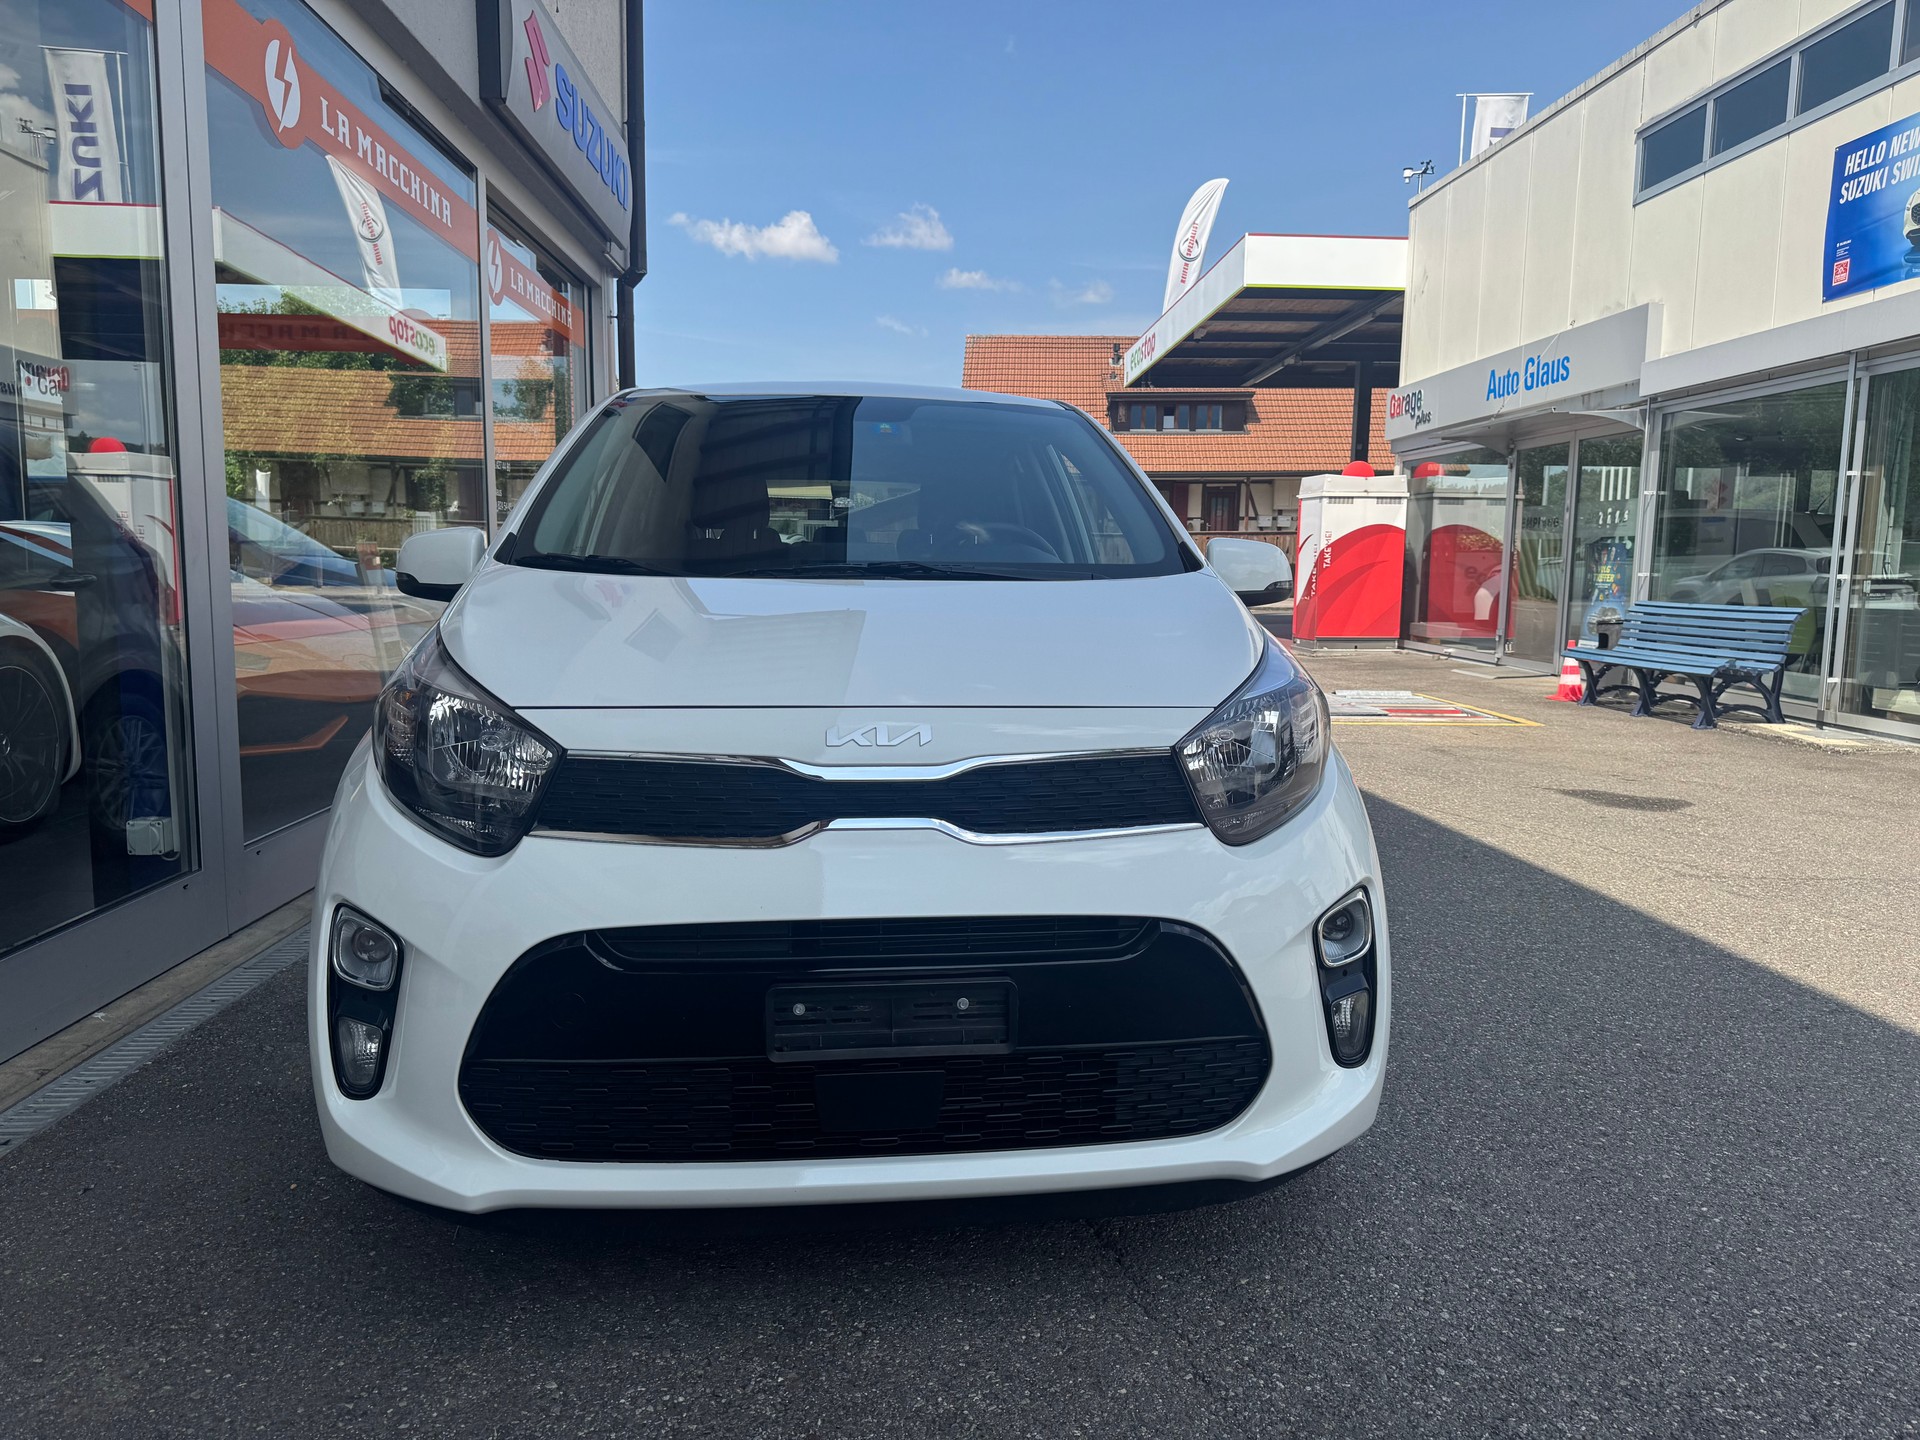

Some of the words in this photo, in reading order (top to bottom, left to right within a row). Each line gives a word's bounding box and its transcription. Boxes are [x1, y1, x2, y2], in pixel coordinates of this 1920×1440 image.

[555, 63, 628, 211] SUZUKI
[1844, 140, 1887, 177] HELLO
[1889, 126, 1920, 159] NEW
[320, 95, 351, 150] LA
[356, 125, 452, 228] MACCHINA
[1839, 165, 1889, 204] SUZUKI
[1891, 153, 1920, 185] SWI
[1186, 220, 1199, 257] SPEZIALIST
[510, 267, 525, 296] LA
[526, 279, 573, 330] MACCHINA
[1130, 332, 1156, 371] ecostop
[1486, 369, 1519, 401] Auto
[1524, 355, 1571, 391] Glaus
[1390, 389, 1423, 420] Garage
[1415, 411, 1432, 429] plus
[1323, 547, 1332, 568] TAKE
[825, 721, 933, 748] KIA
